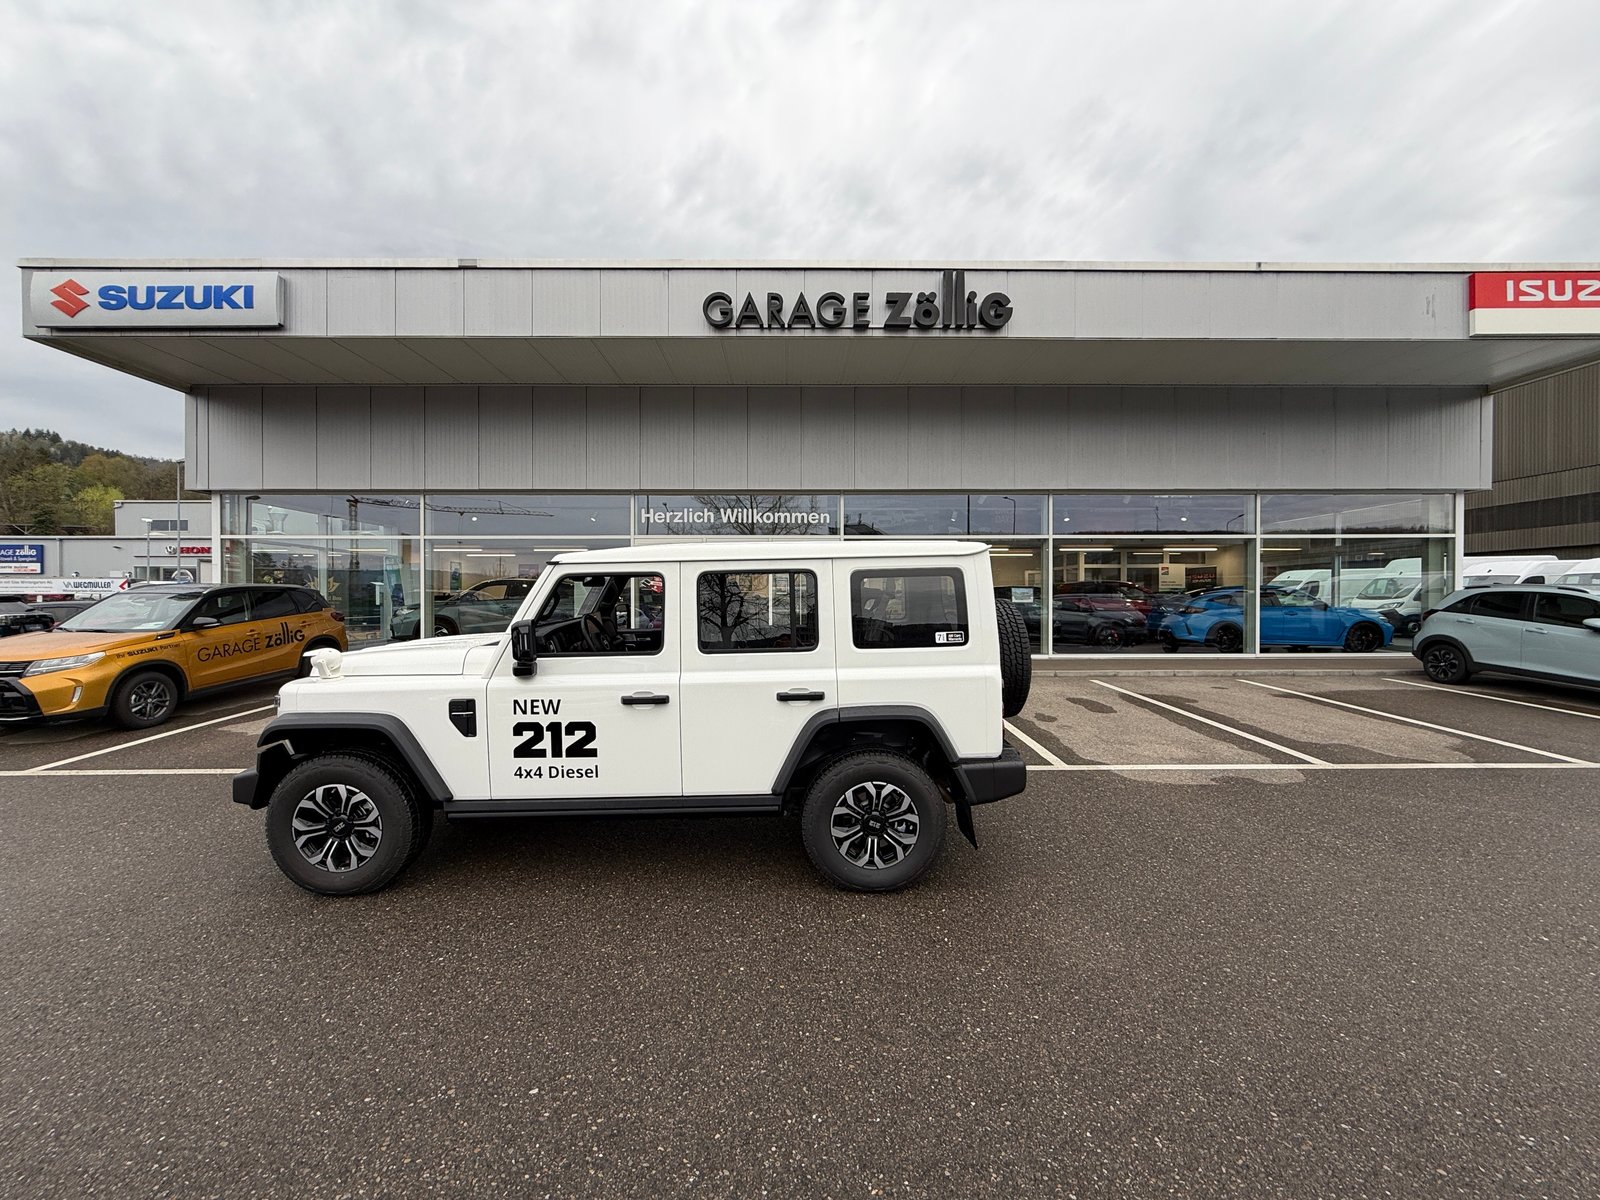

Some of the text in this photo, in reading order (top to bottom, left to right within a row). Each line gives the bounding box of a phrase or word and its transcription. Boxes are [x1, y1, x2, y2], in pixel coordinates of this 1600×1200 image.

[98, 285, 254, 310] SUZUKI
[1506, 279, 1600, 302] ISUZ
[703, 291, 870, 330] GARAGE
[641, 508, 830, 524] Herzlich Willkommen
[127, 646, 158, 657] SUZUKI
[197, 638, 261, 662] GARAGE
[513, 699, 561, 715] NEW
[512, 721, 598, 758] 212
[514, 765, 599, 779] 4x4 Diesel
